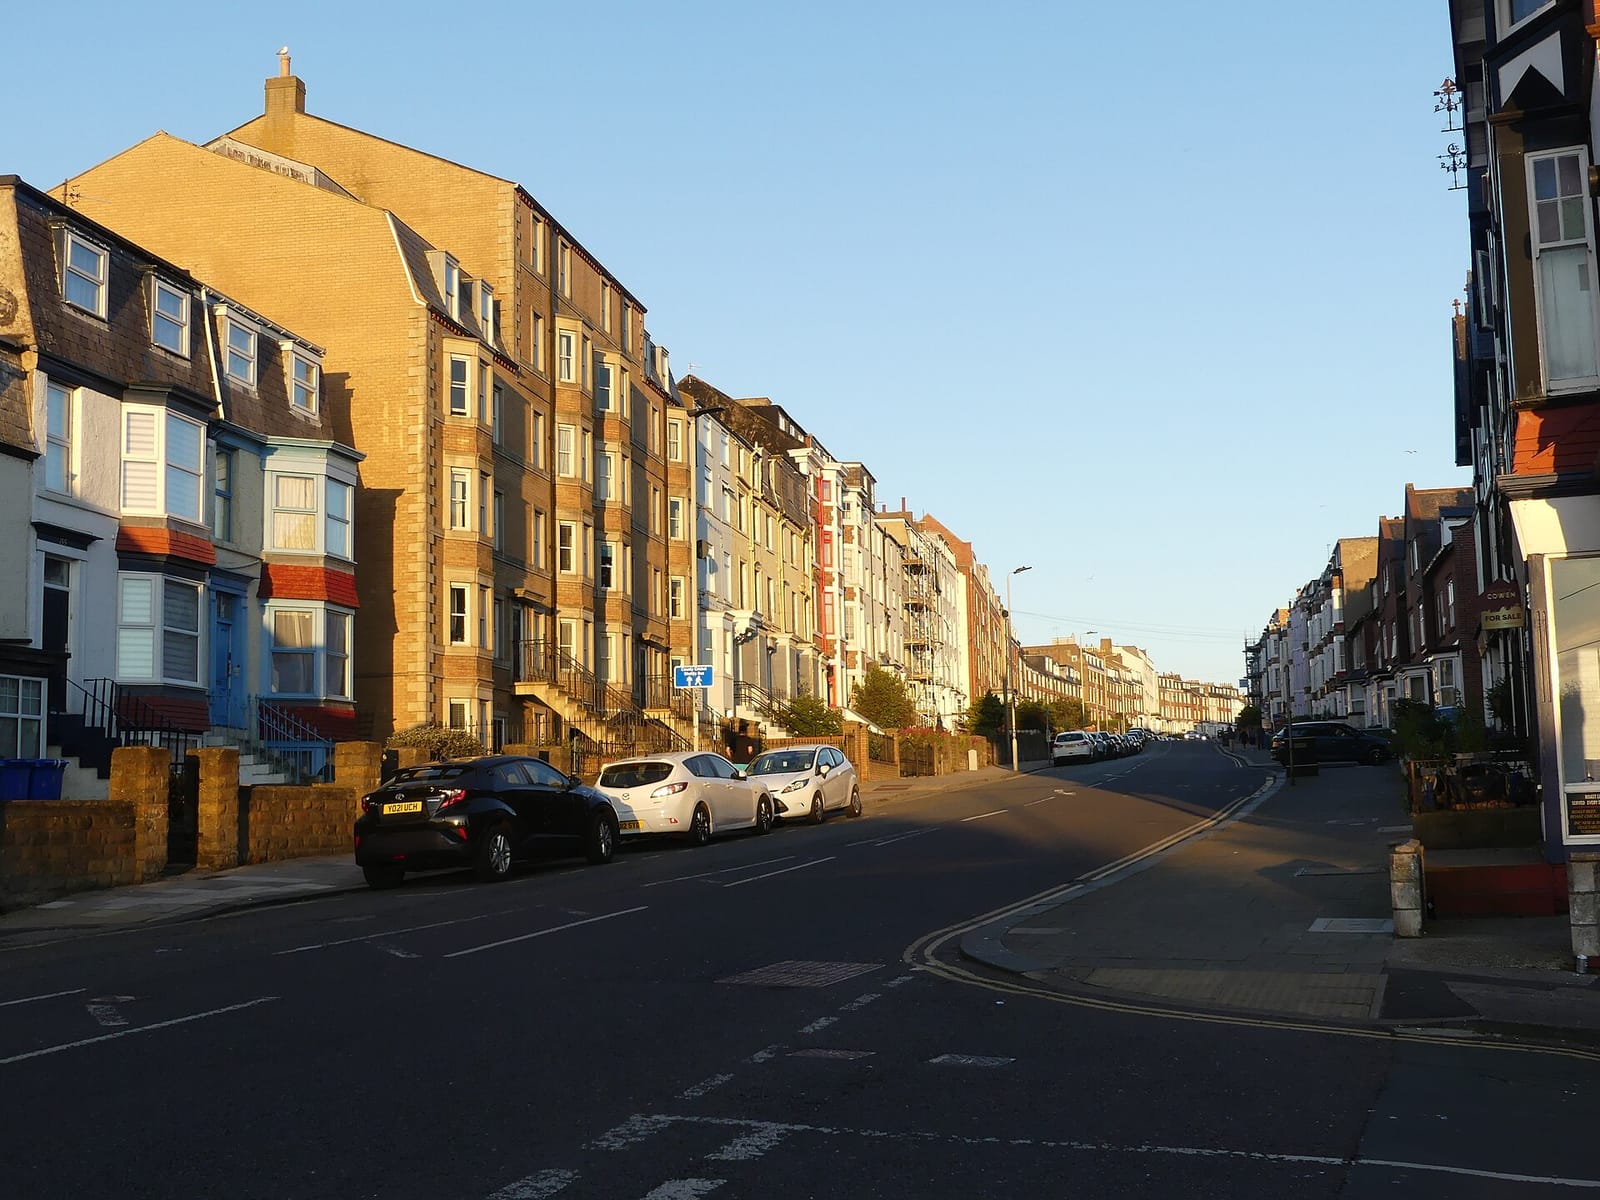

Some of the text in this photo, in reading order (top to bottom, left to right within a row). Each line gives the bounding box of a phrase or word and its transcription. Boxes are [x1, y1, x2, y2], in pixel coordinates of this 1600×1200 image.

[1485, 612, 1522, 622] FOR SALE
[404, 803, 418, 811] UCH
